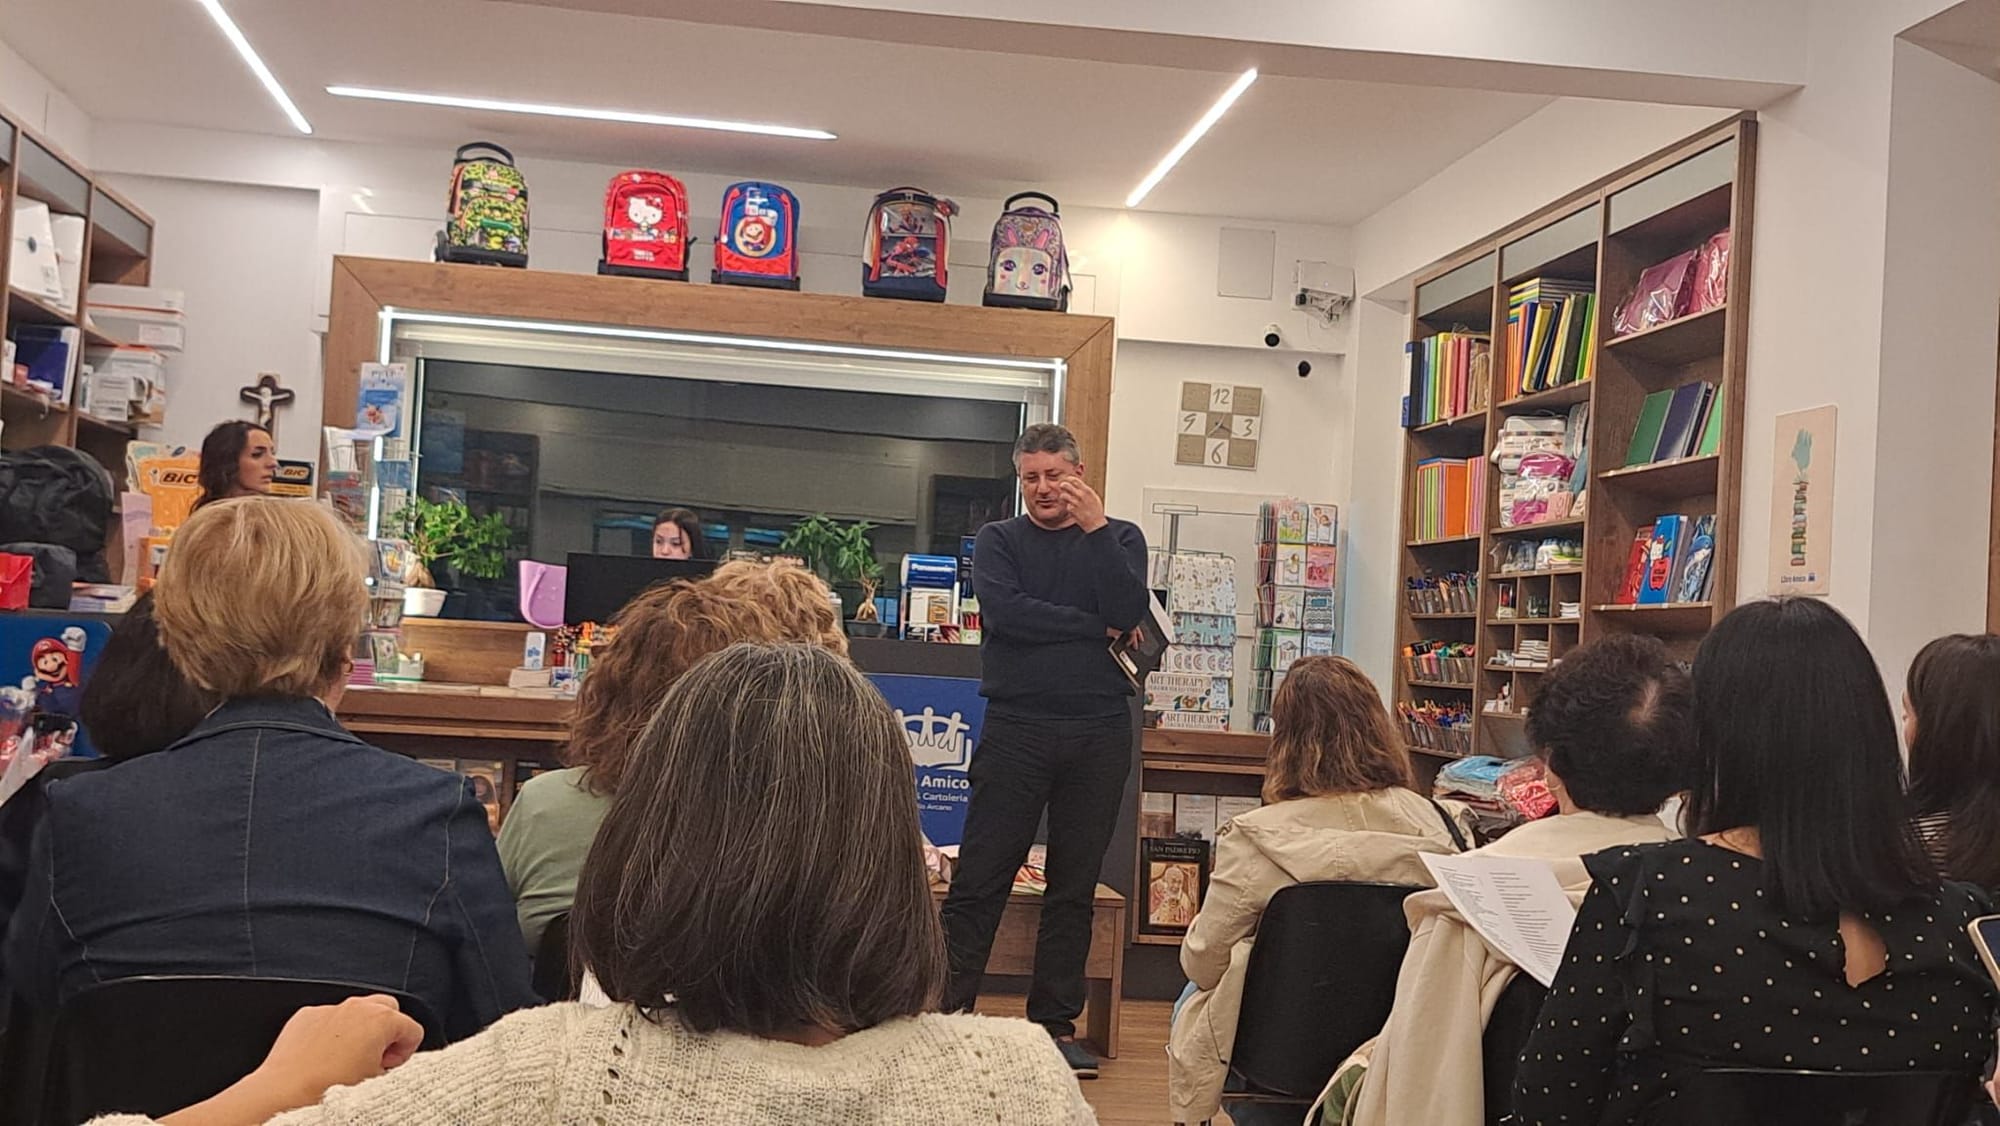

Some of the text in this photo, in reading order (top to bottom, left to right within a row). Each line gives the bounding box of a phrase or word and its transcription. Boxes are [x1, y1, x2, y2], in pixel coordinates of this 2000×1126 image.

[1213, 388, 1230, 405] 12
[1183, 413, 1197, 432] 9
[1243, 418, 1254, 437] 3
[1211, 441, 1225, 465] 6
[921, 775, 970, 789] Amico
[922, 792, 968, 802] Cartoleria
